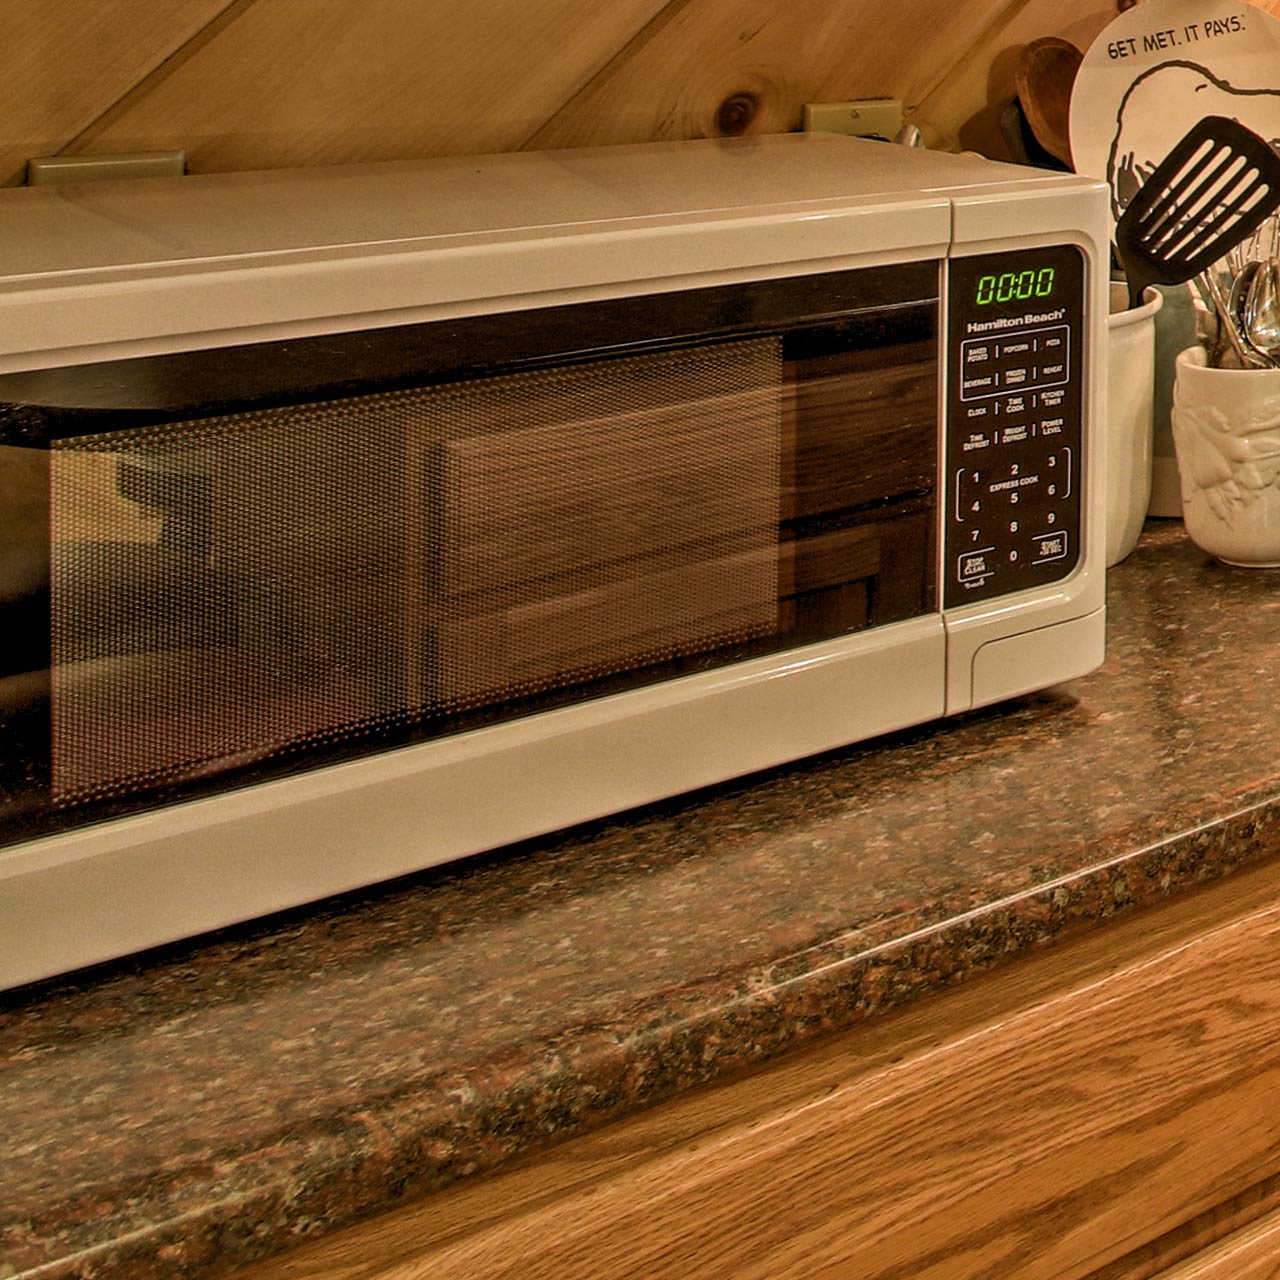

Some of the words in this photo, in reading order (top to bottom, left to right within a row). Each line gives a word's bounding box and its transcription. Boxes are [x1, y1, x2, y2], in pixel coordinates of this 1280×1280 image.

[1107, 38, 1137, 60] GET
[1143, 29, 1182, 53] MET.
[1184, 24, 1199, 43] IT
[976, 267, 1055, 305] 00:00
[966, 317, 1024, 333] Hamilton
[1024, 309, 1064, 325] Beach
[1003, 343, 1030, 354] POPCORN
[967, 353, 989, 363] POTATO
[1005, 368, 1027, 378] FROZEN
[1043, 364, 1063, 375] REHEAT
[963, 376, 993, 389] BEVERAGE
[1040, 389, 1065, 400] KITCHEN
[1044, 397, 1062, 407] TIMER
[967, 407, 987, 418] CLOCK
[1006, 403, 1025, 414] COOK
[1041, 418, 1064, 429] POWER
[1003, 425, 1026, 436] WEIGHT
[1042, 426, 1062, 436] LEVEL
[1002, 431, 1028, 444] DEFROST
[963, 439, 990, 452] DEFROST
[1047, 456, 1056, 468] 3
[1010, 464, 1019, 475] 2
[971, 471, 979, 483] 1
[989, 479, 1019, 493] EXPRESS
[1019, 475, 1039, 486] COOK
[1047, 484, 1056, 496] 6
[1010, 492, 1019, 504] 5
[971, 500, 980, 512] 4
[1047, 513, 1056, 524] 9
[1010, 521, 1018, 533] 8
[971, 530, 980, 541] 7
[1009, 550, 1018, 562] 0
[964, 564, 986, 576] CLEAR
